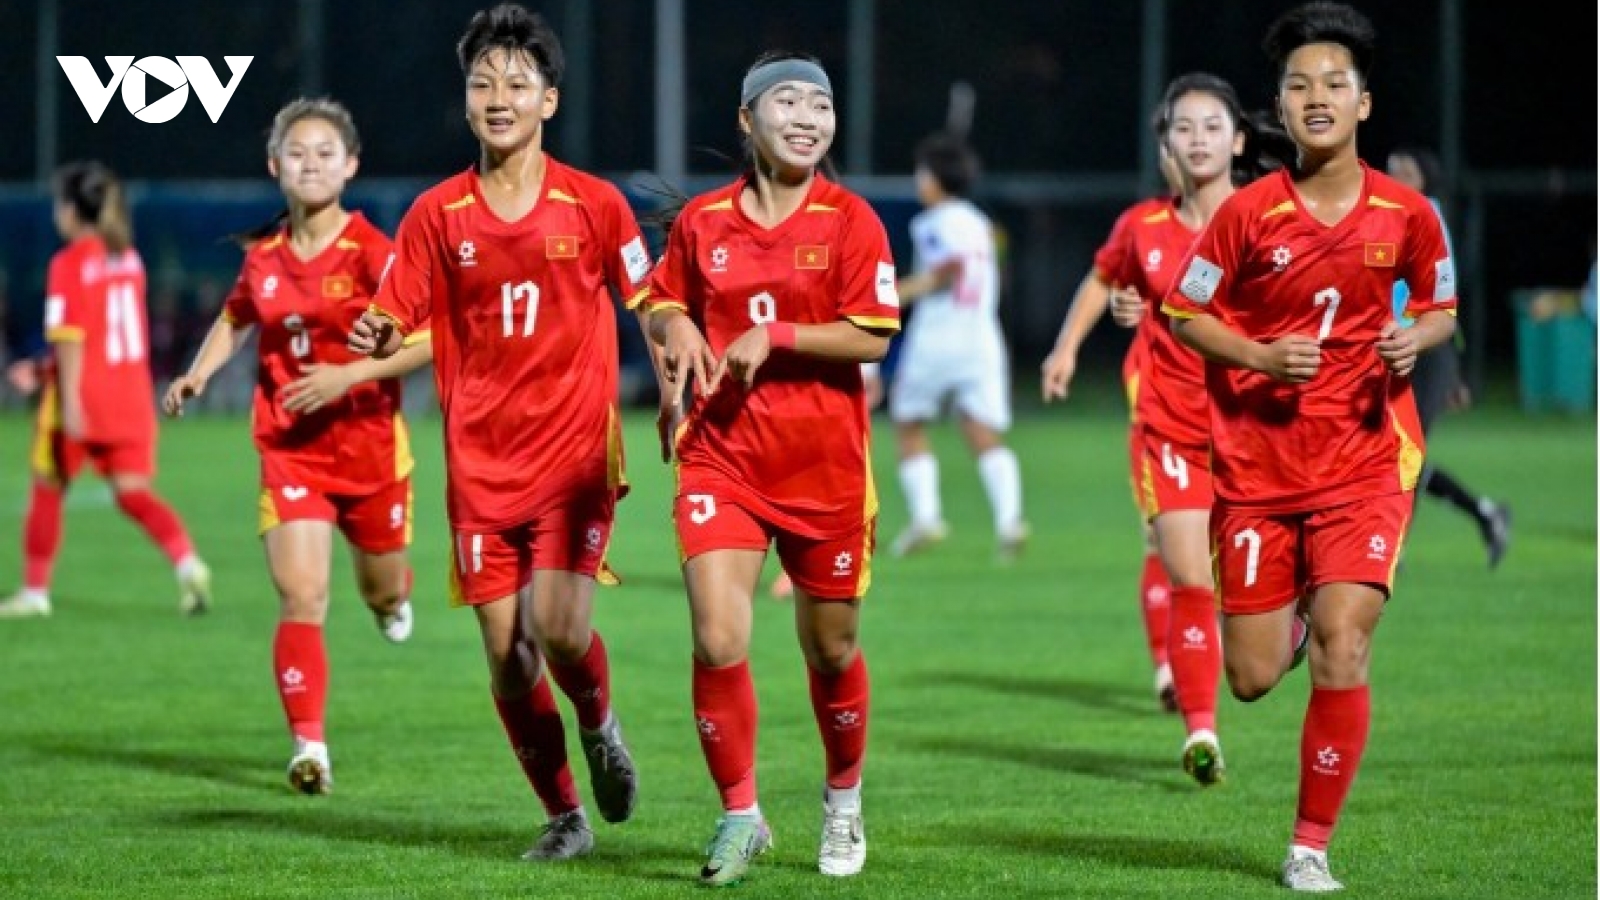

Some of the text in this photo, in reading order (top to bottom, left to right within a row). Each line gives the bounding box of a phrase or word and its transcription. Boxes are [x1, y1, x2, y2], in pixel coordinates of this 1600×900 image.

[106, 282, 143, 364] 11
[501, 281, 539, 337] 17
[1313, 287, 1341, 340] 7
[1162, 443, 1189, 490] 4
[1234, 527, 1261, 587] 7
